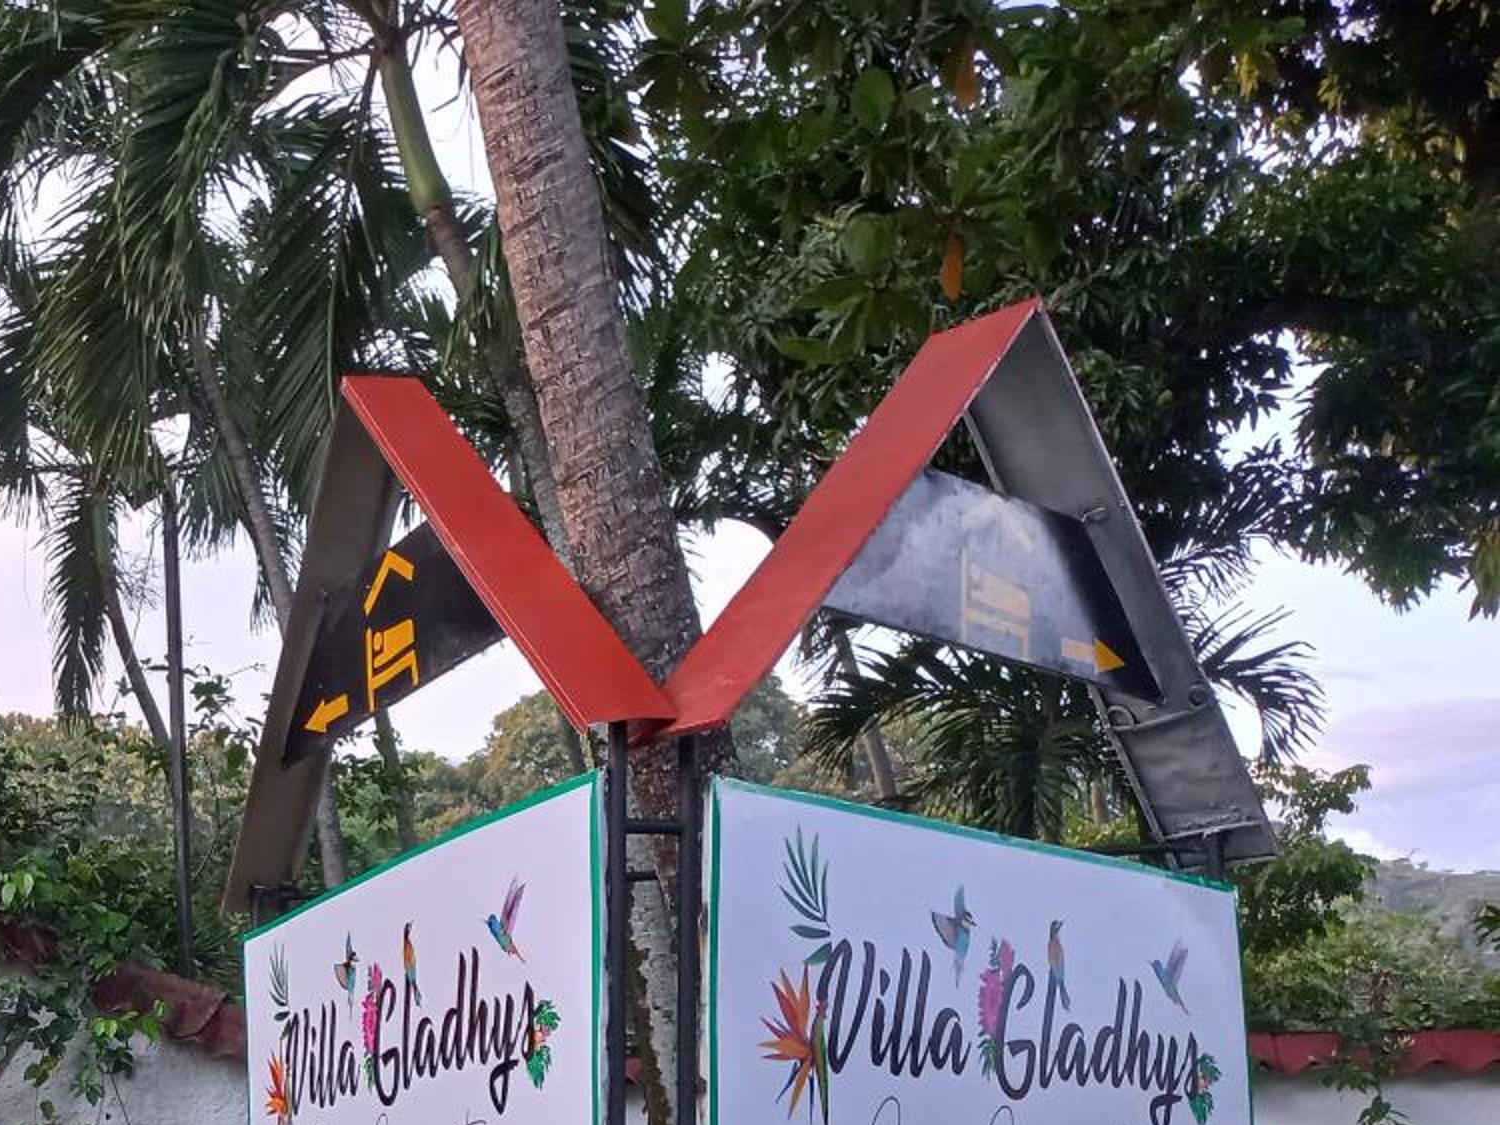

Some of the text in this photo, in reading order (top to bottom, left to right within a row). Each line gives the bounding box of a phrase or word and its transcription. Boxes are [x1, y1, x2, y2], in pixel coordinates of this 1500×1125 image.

[283, 946, 536, 1117] Villa Gladhys
[817, 938, 972, 1077] Villa
